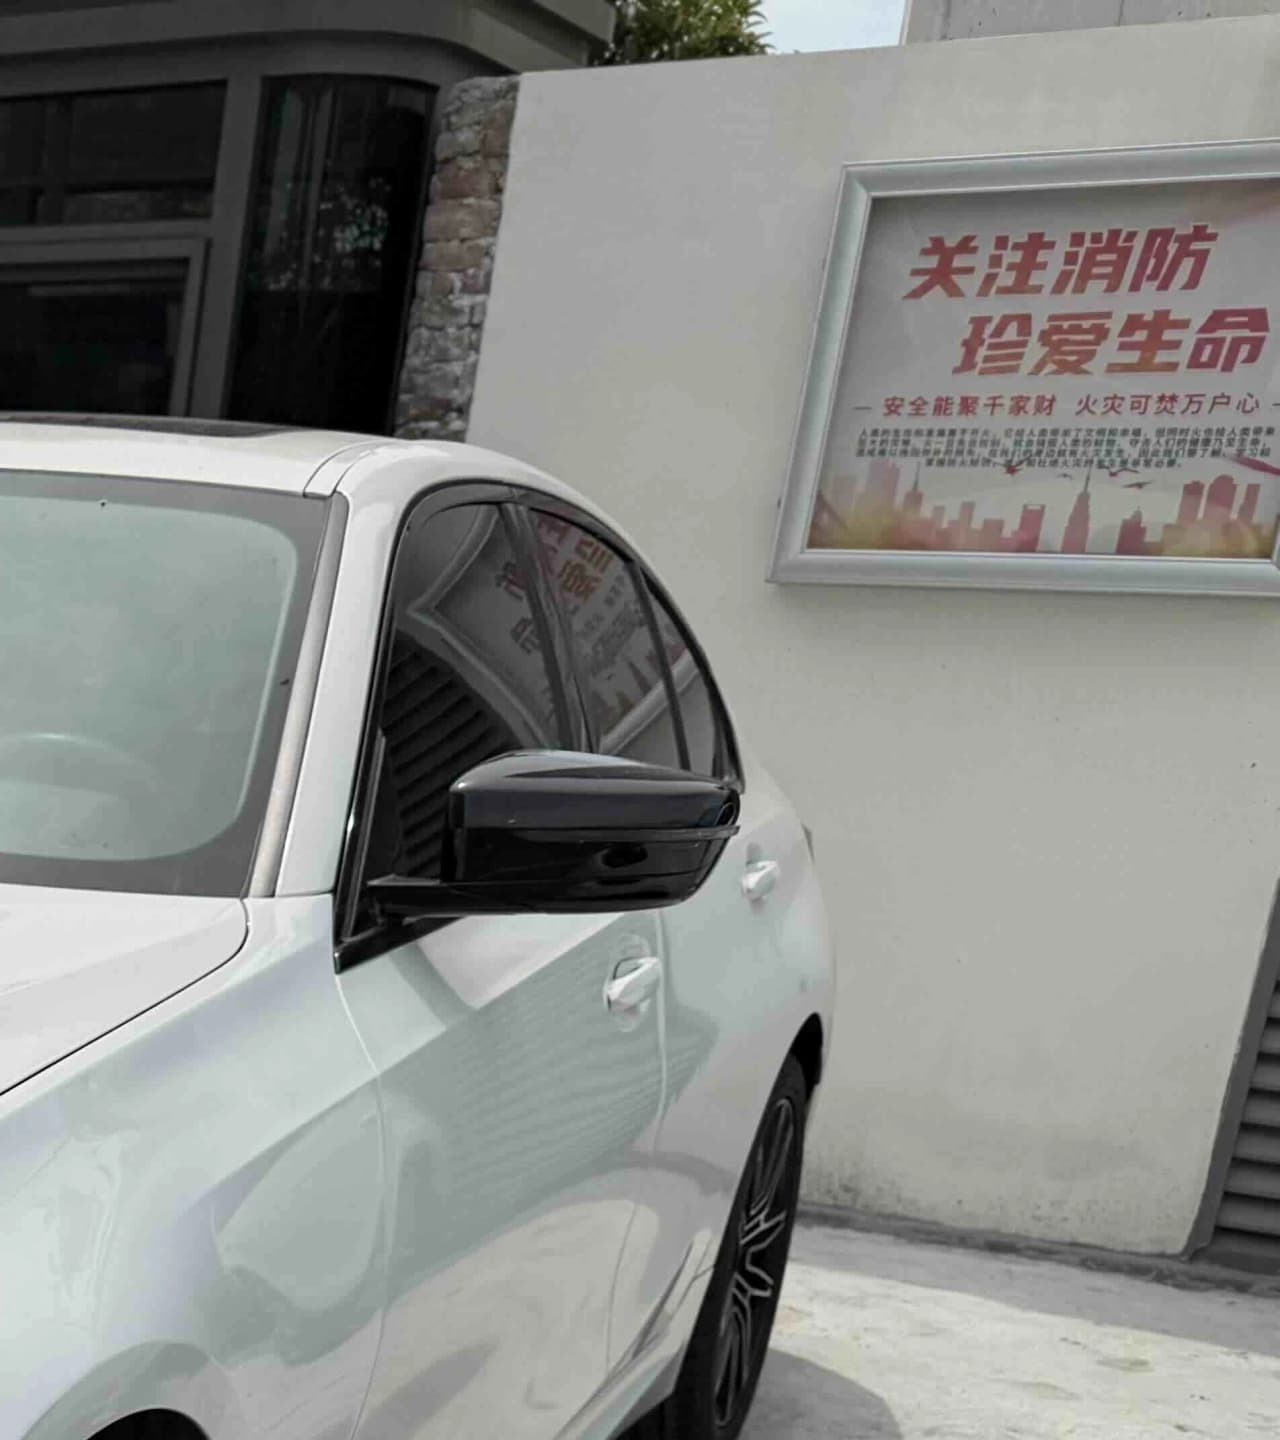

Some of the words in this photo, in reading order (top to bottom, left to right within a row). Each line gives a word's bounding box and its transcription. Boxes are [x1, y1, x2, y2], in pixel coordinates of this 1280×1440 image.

[901, 224, 1218, 300] 关注消防
[952, 307, 1270, 376] 珍爱生命
[882, 394, 1057, 417] 安全能聚千家财
[1075, 392, 1260, 415] 火灾可焚万户心
